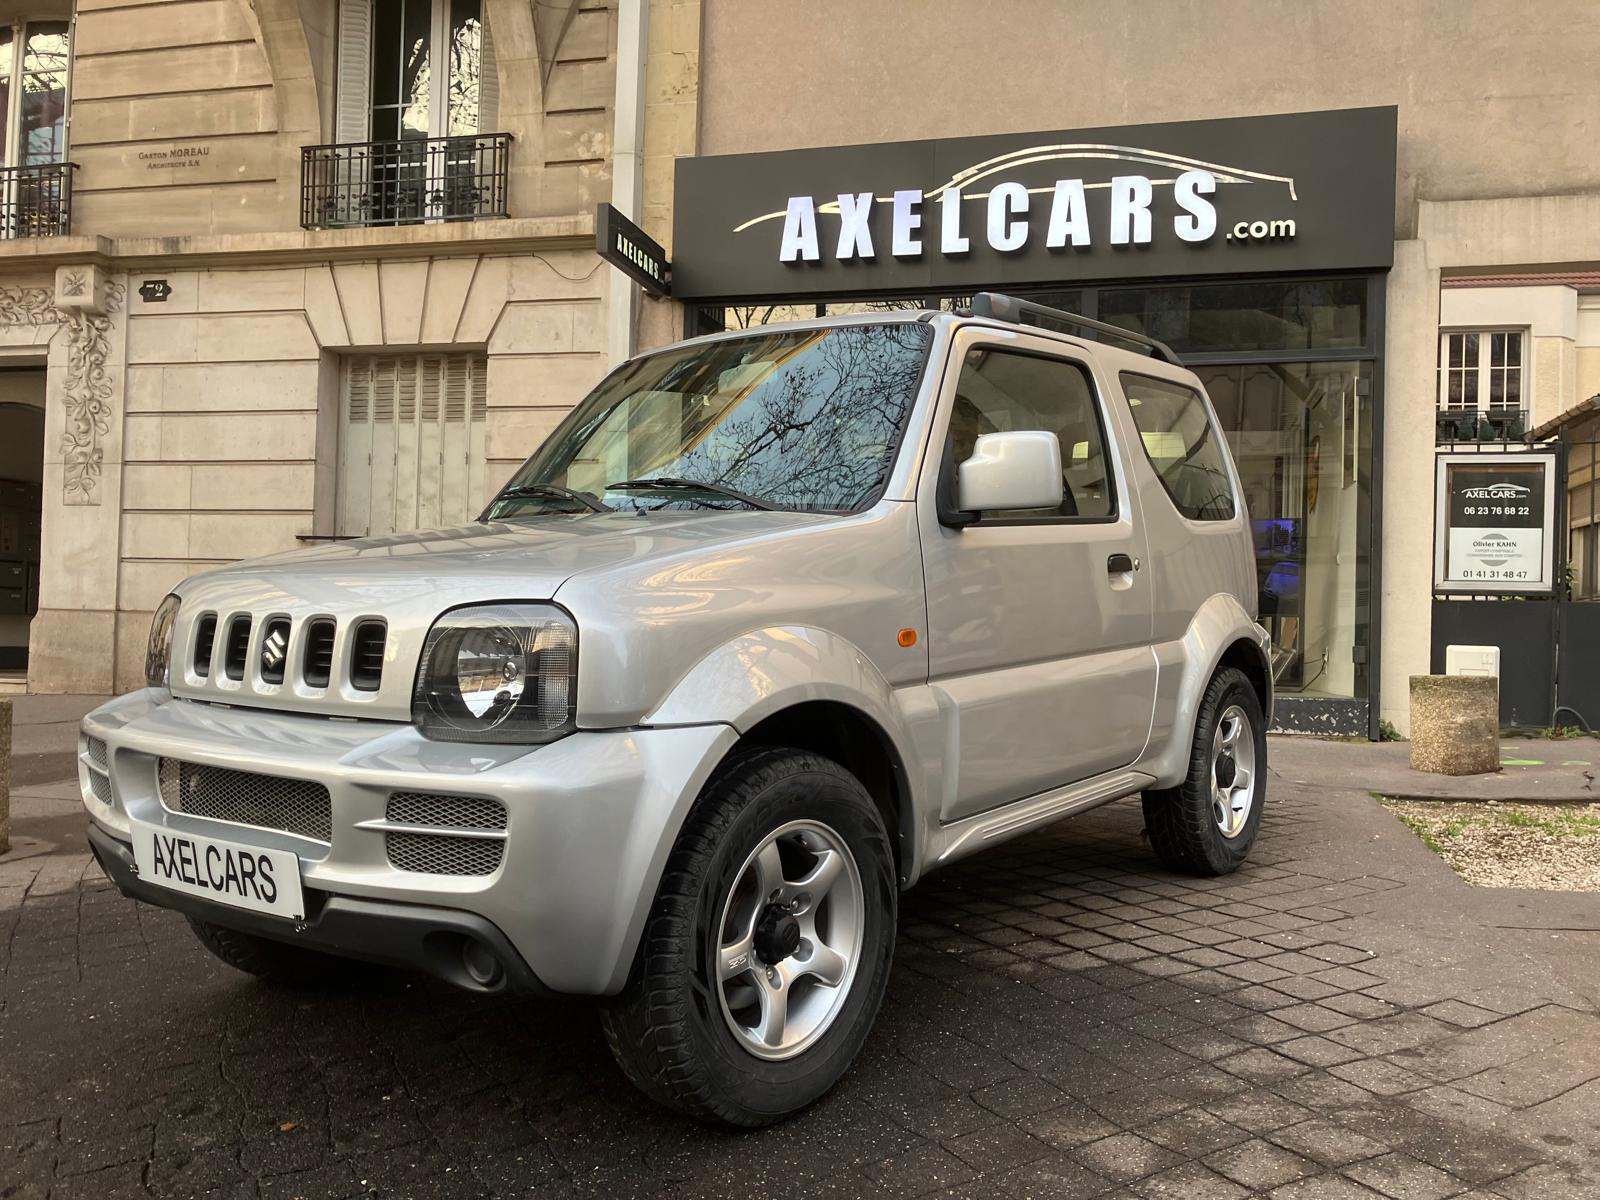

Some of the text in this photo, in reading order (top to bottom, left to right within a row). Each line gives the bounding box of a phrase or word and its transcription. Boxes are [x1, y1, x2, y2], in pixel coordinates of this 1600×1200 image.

[170, 147, 210, 158] MOREAU
[616, 233, 659, 280] AXELCARS
[1464, 507, 1530, 515] 06 23 76 68 22
[1463, 570, 1528, 579] 01 41 31 48 47
[153, 833, 277, 904] AXELCARS
